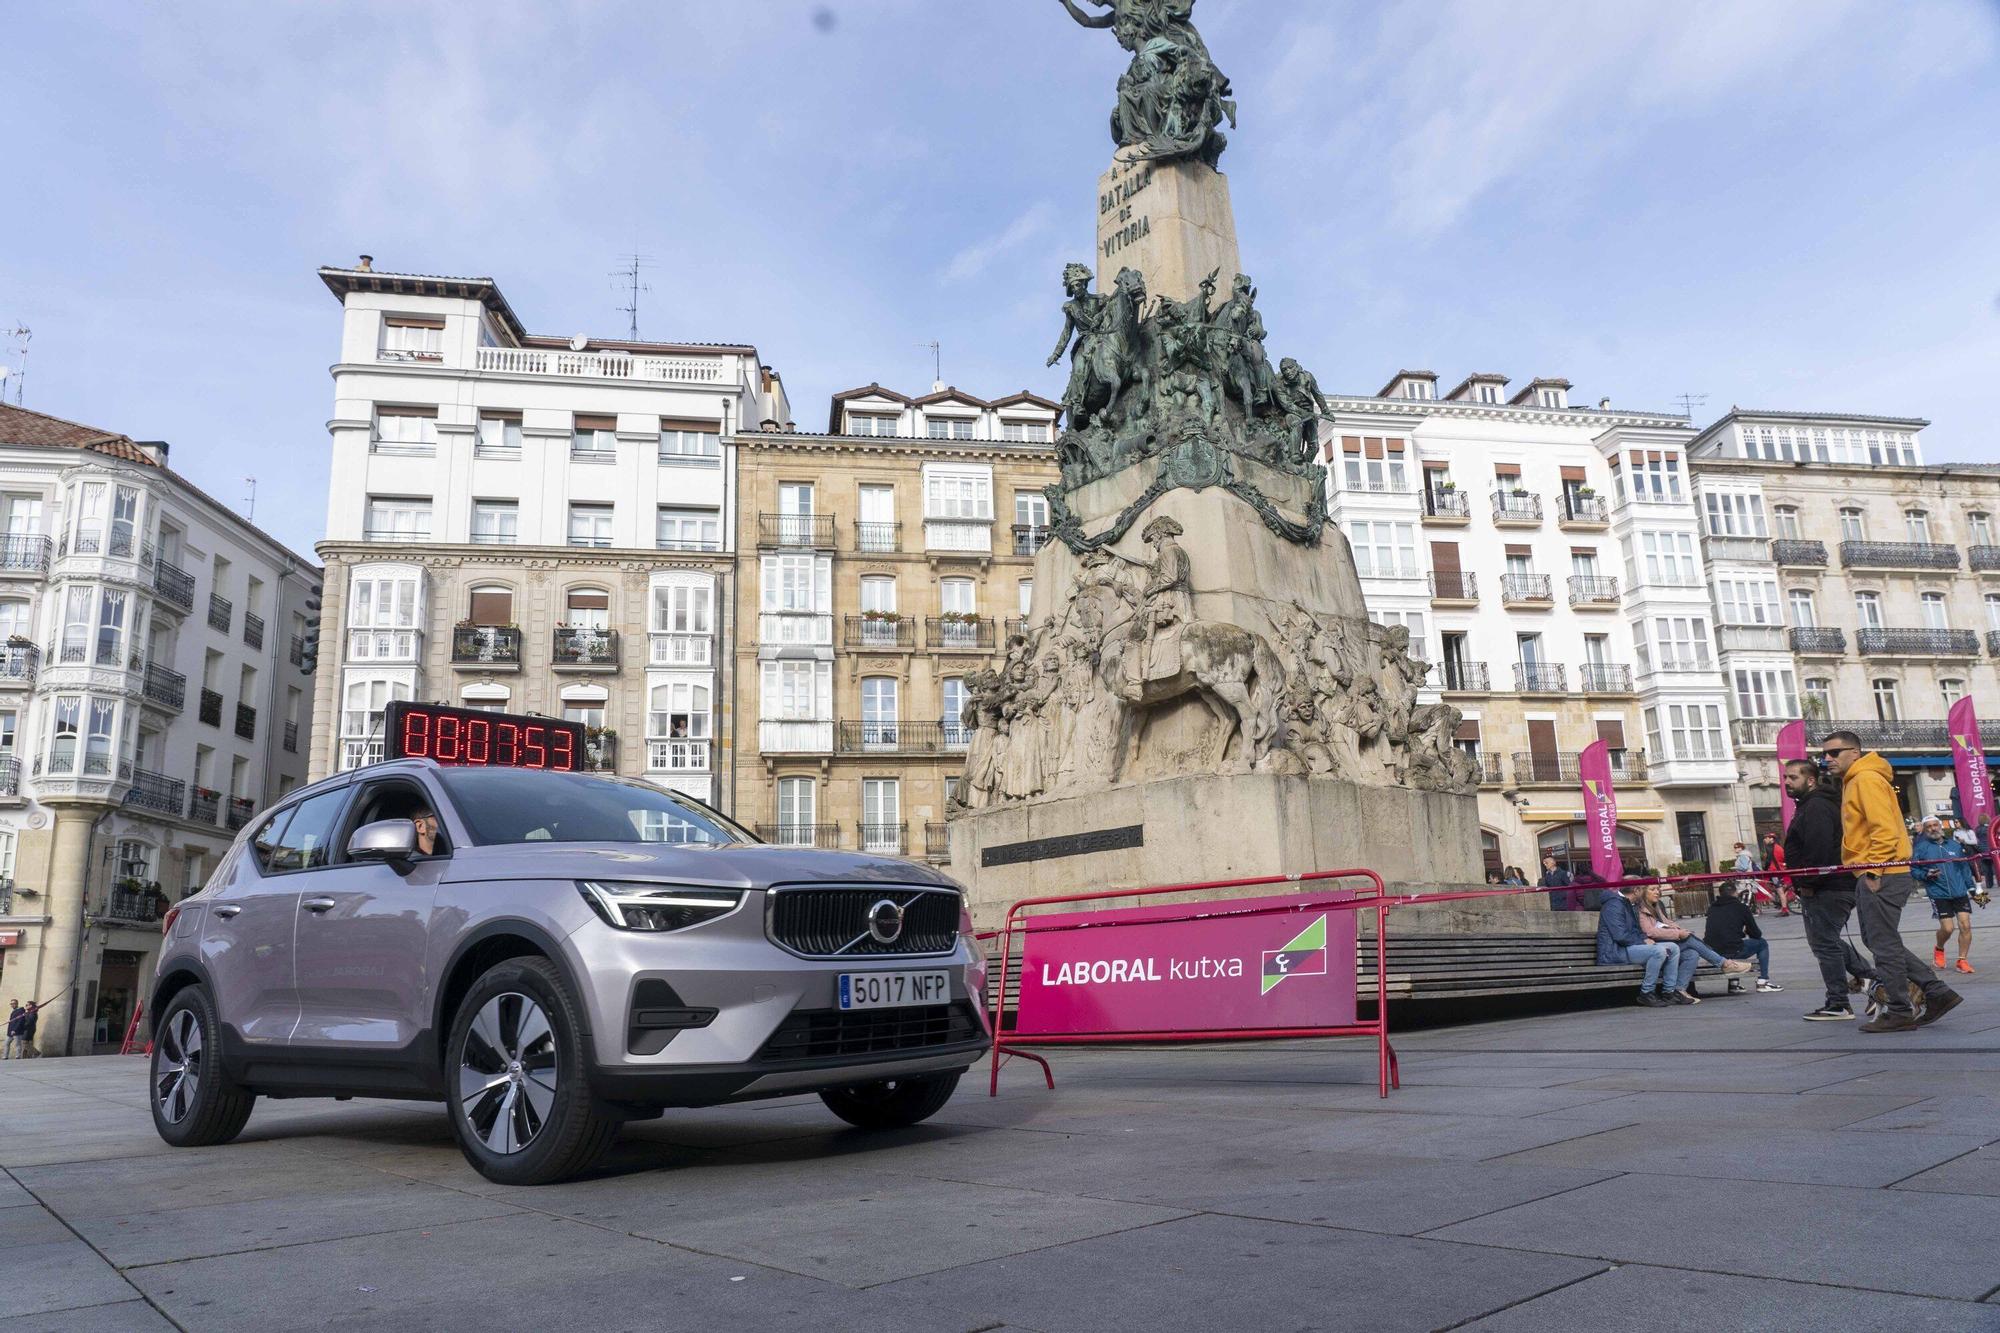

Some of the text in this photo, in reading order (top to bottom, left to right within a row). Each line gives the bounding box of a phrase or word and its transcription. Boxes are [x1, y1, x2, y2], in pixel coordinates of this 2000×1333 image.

[1112, 167, 1118, 181] A
[1101, 167, 1151, 215] BATALLA
[1120, 205, 1132, 223] DE
[1104, 215, 1150, 258] VITORIA
[1968, 756, 1985, 807] LABORAL
[1042, 956, 1243, 986] LABORAL kutxa
[855, 975, 944, 1003] 5017 NFP
